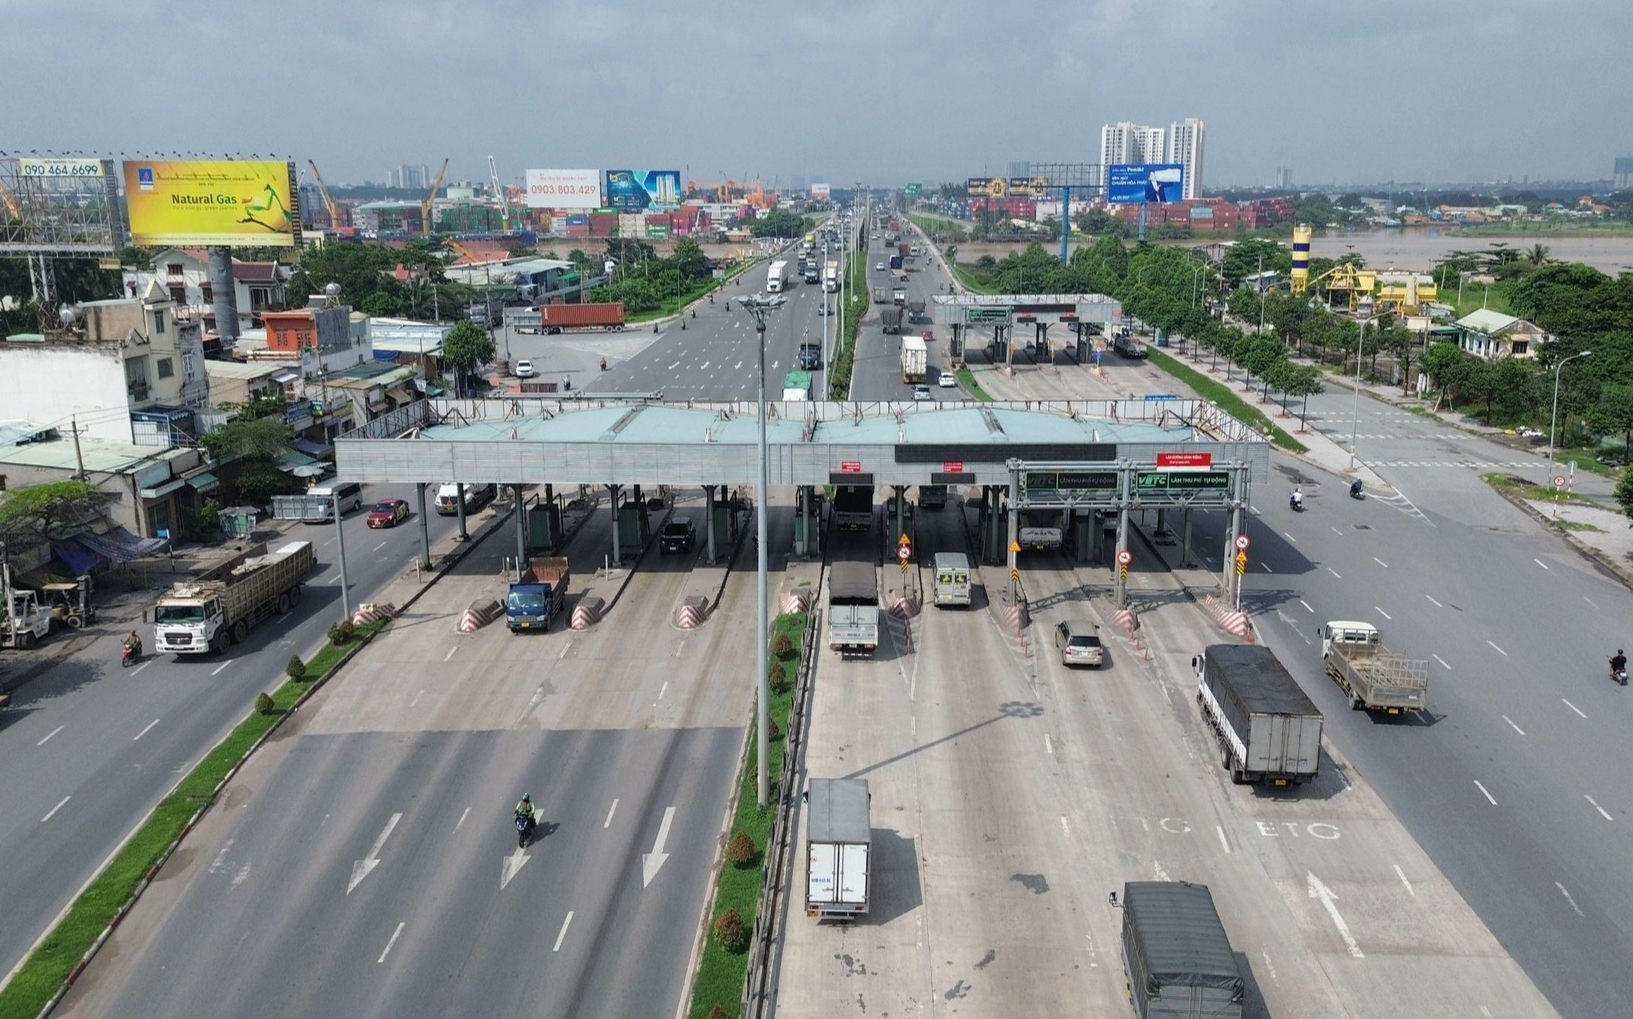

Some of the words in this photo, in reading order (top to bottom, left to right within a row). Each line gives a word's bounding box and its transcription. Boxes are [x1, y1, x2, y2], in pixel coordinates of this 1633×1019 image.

[24, 165, 45, 175] 090
[48, 165, 68, 175] 464
[71, 165, 98, 175] 6699
[531, 185, 596, 195] 0903.803.429
[172, 194, 214, 204] Natural
[216, 194, 237, 204] Gas
[1139, 475, 1167, 486] VETC
